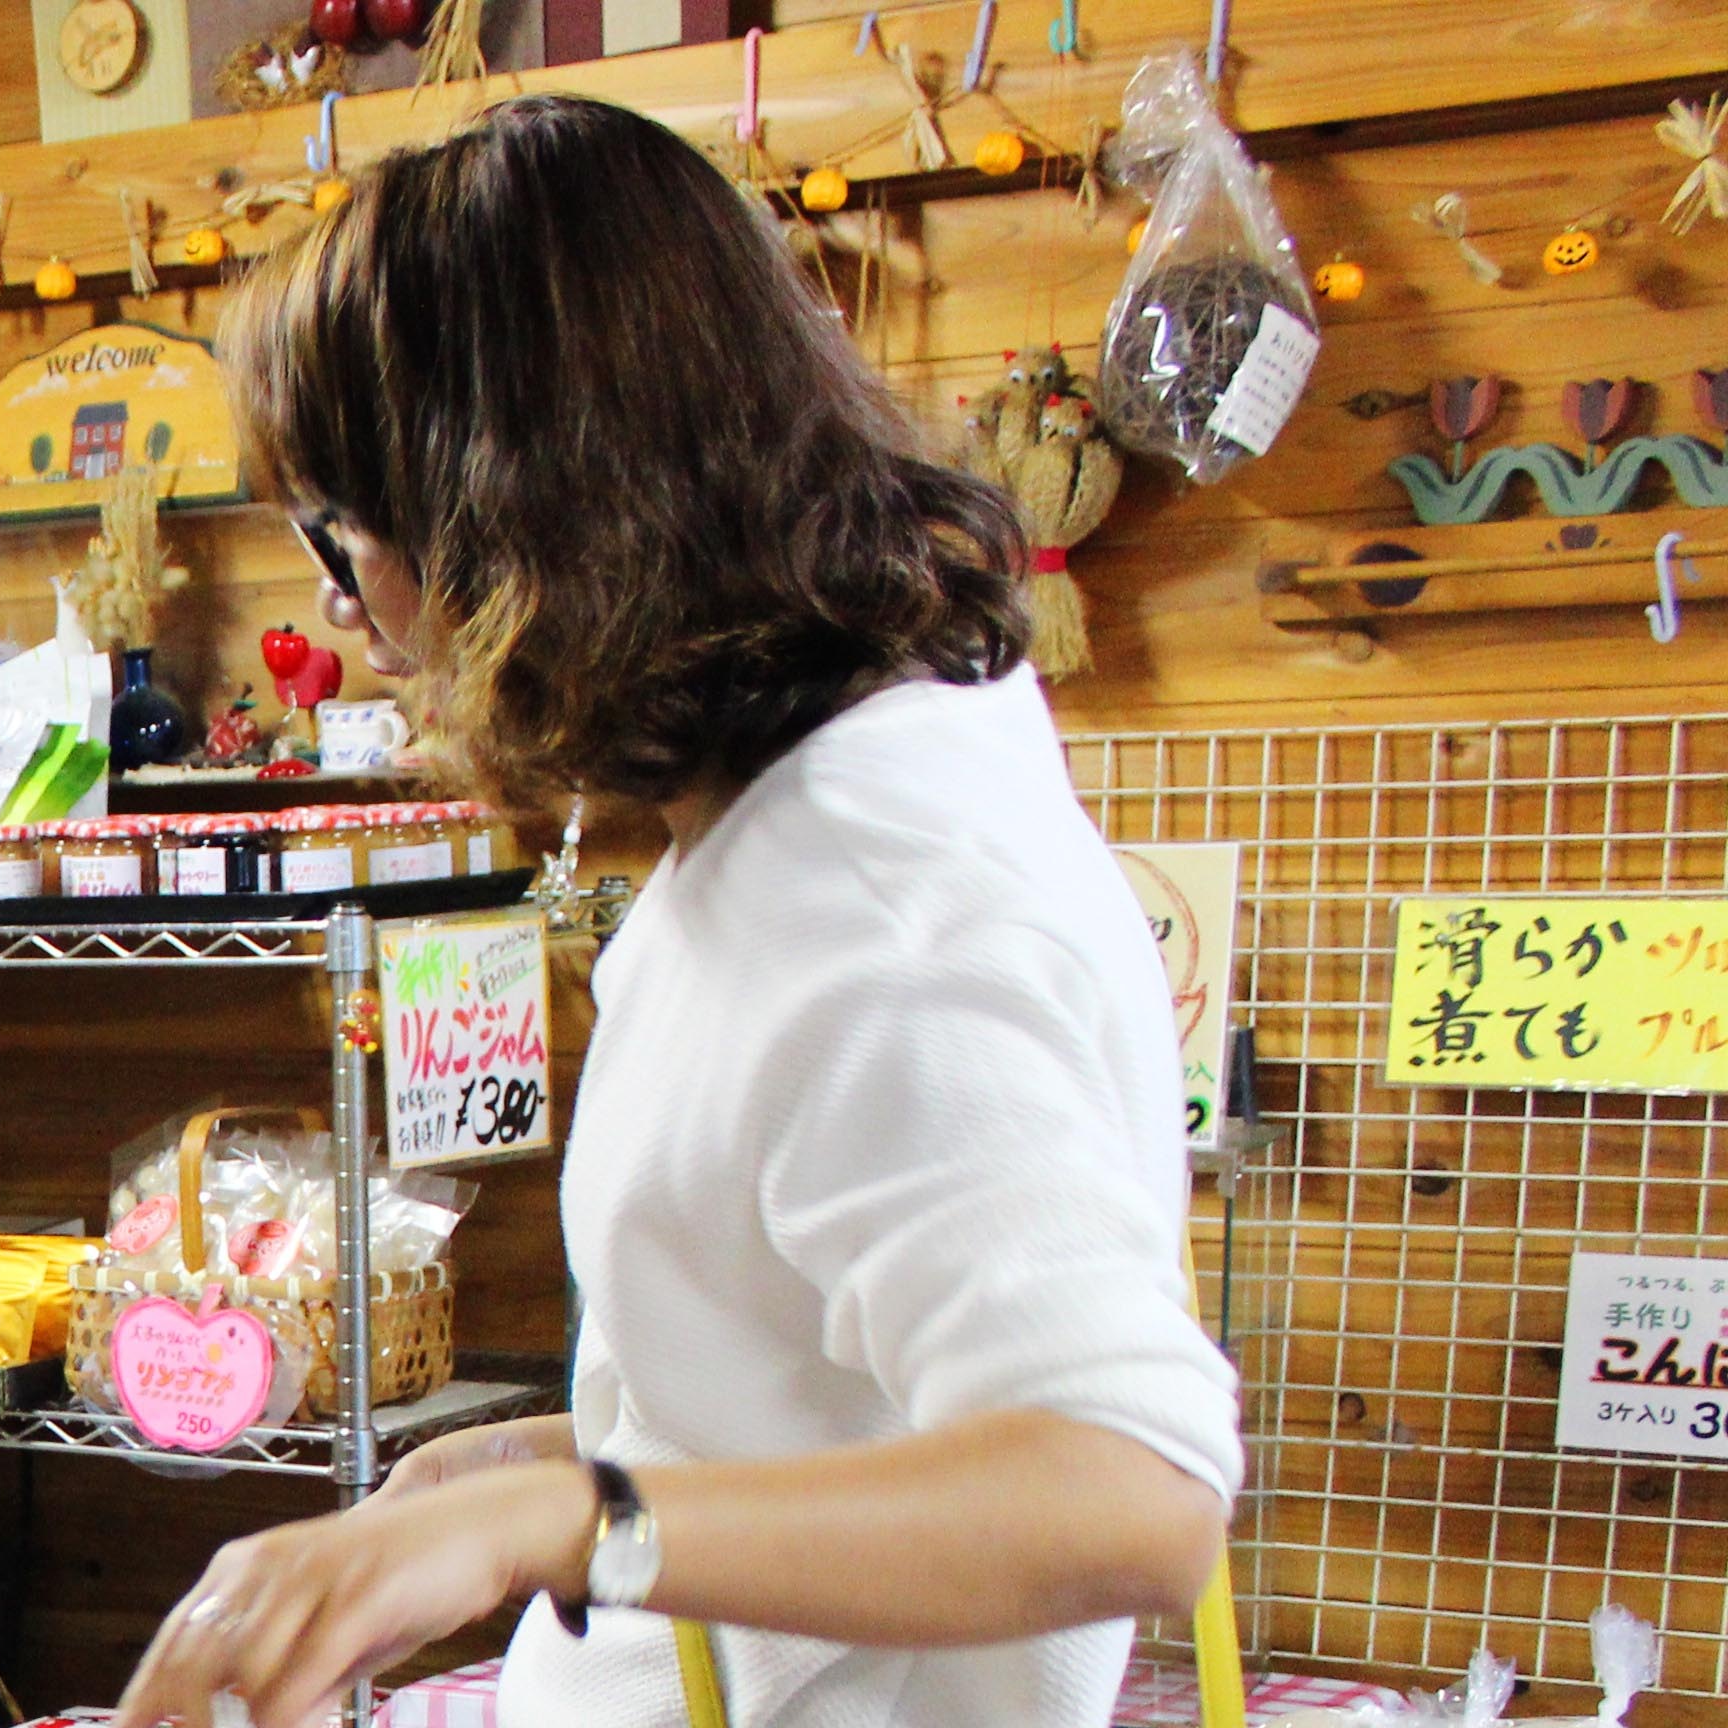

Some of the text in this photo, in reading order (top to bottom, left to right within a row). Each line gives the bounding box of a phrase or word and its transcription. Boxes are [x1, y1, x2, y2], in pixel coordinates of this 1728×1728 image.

[46, 341, 166, 377] welcome
[1415, 905, 1626, 991] 滑らか
[400, 1000, 546, 1084] りんごジャム
[1408, 991, 1602, 1068] 煮ても
[1605, 1302, 1692, 1331] 手作り
